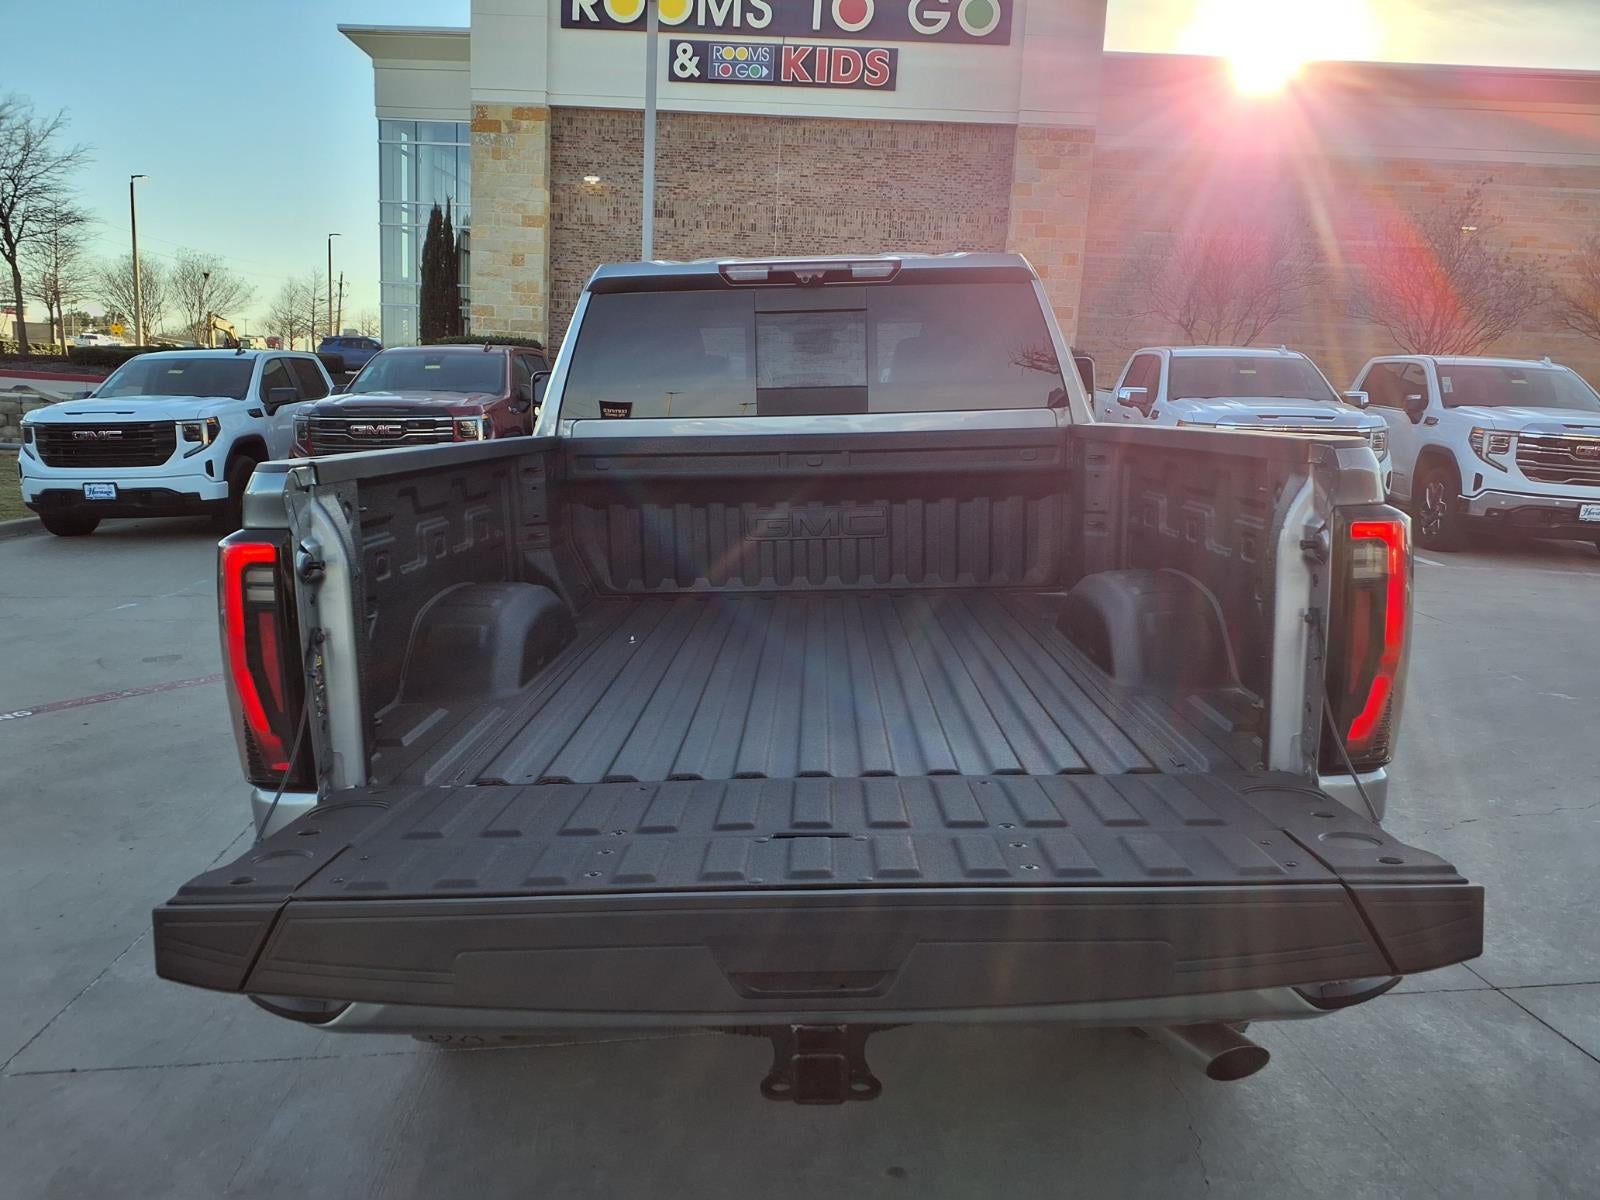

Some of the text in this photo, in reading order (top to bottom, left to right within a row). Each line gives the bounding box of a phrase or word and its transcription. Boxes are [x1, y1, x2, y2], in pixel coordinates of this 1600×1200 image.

[908, 0, 1001, 37] GO
[673, 42, 701, 78] &
[713, 45, 770, 61] ROOMS
[713, 63, 762, 79] TO GO
[781, 46, 890, 86] KIDS
[72, 430, 122, 440] GMC
[350, 424, 402, 435] GMC
[744, 505, 887, 539] GMC
